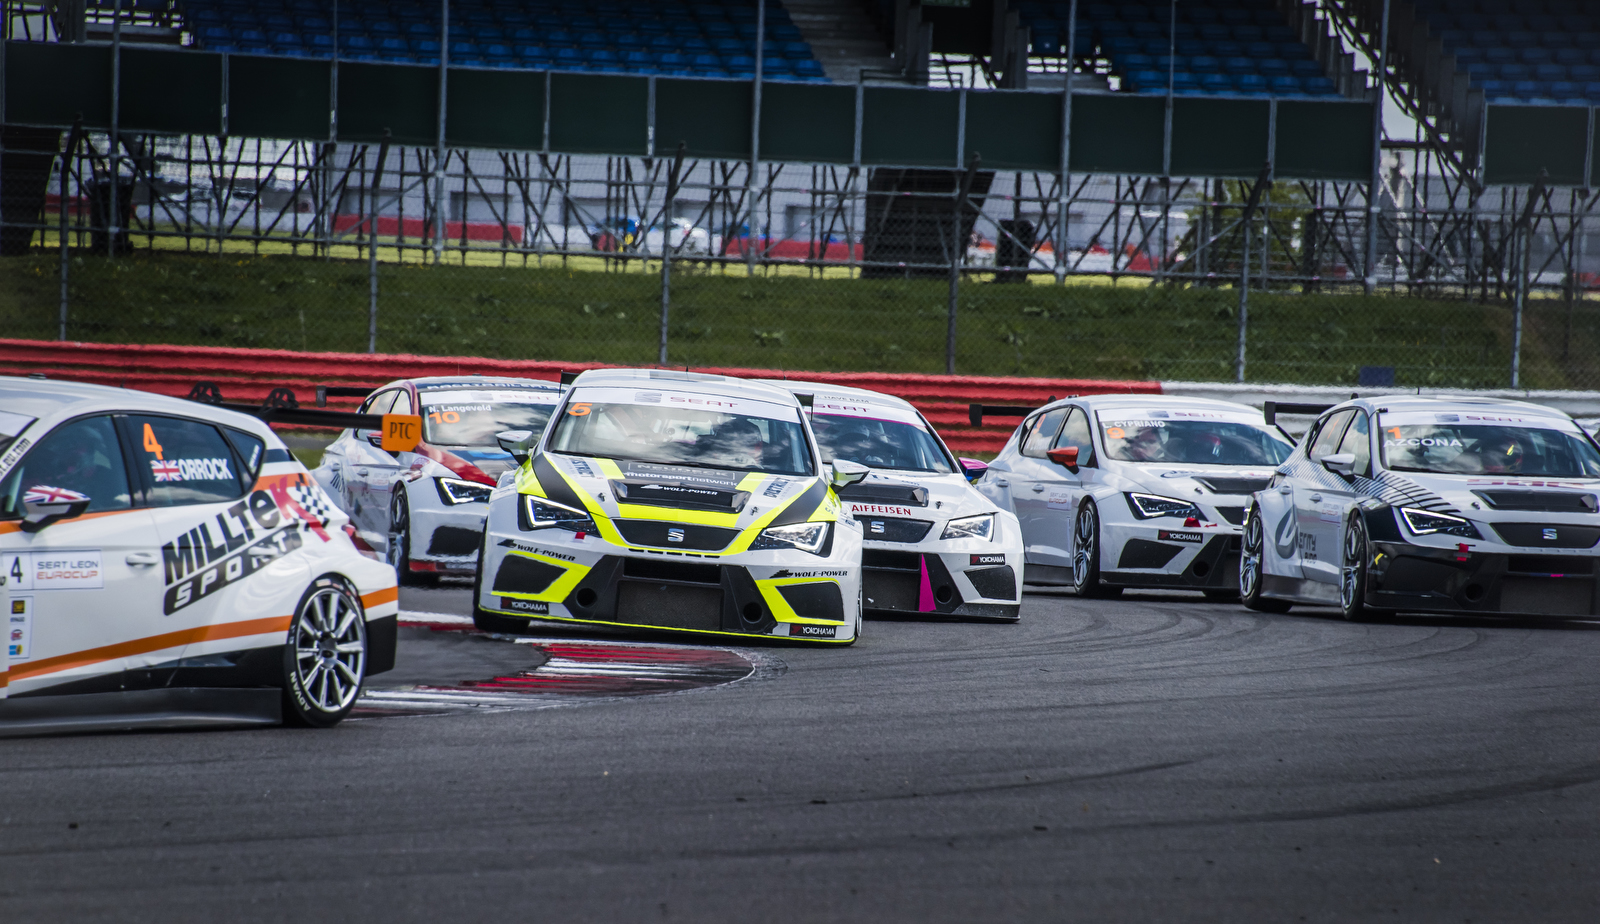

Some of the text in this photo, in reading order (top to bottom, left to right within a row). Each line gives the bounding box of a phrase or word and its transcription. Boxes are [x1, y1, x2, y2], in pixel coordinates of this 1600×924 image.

[670, 397, 738, 408] SEAT
[813, 404, 870, 412] SEAT
[429, 405, 492, 413] N. Langeveld
[568, 403, 593, 417] 5
[428, 411, 461, 425] 10
[389, 422, 416, 440] PTC
[1106, 427, 1125, 439] 9
[1388, 427, 1402, 439] 1
[143, 423, 163, 460] 4
[1384, 438, 1463, 447] AZCONA
[178, 458, 234, 480] ORROCK
[624, 472, 739, 487] motorsportnetwork
[663, 486, 718, 496] WOLF-POWER
[851, 504, 912, 516] AIFFEISEN
[1169, 532, 1201, 542] YOKOHAMA
[517, 544, 576, 561] WOLF-POWER
[37, 560, 99, 570] SEAT LEON
[977, 556, 1006, 564] YOKOHAMA
[10, 556, 23, 583] 4
[36, 570, 98, 580] EUROCUP
[511, 601, 547, 611] YOKOHAMA
[801, 626, 835, 635] YOKOHAMA
[290, 671, 311, 712] ADVAN
